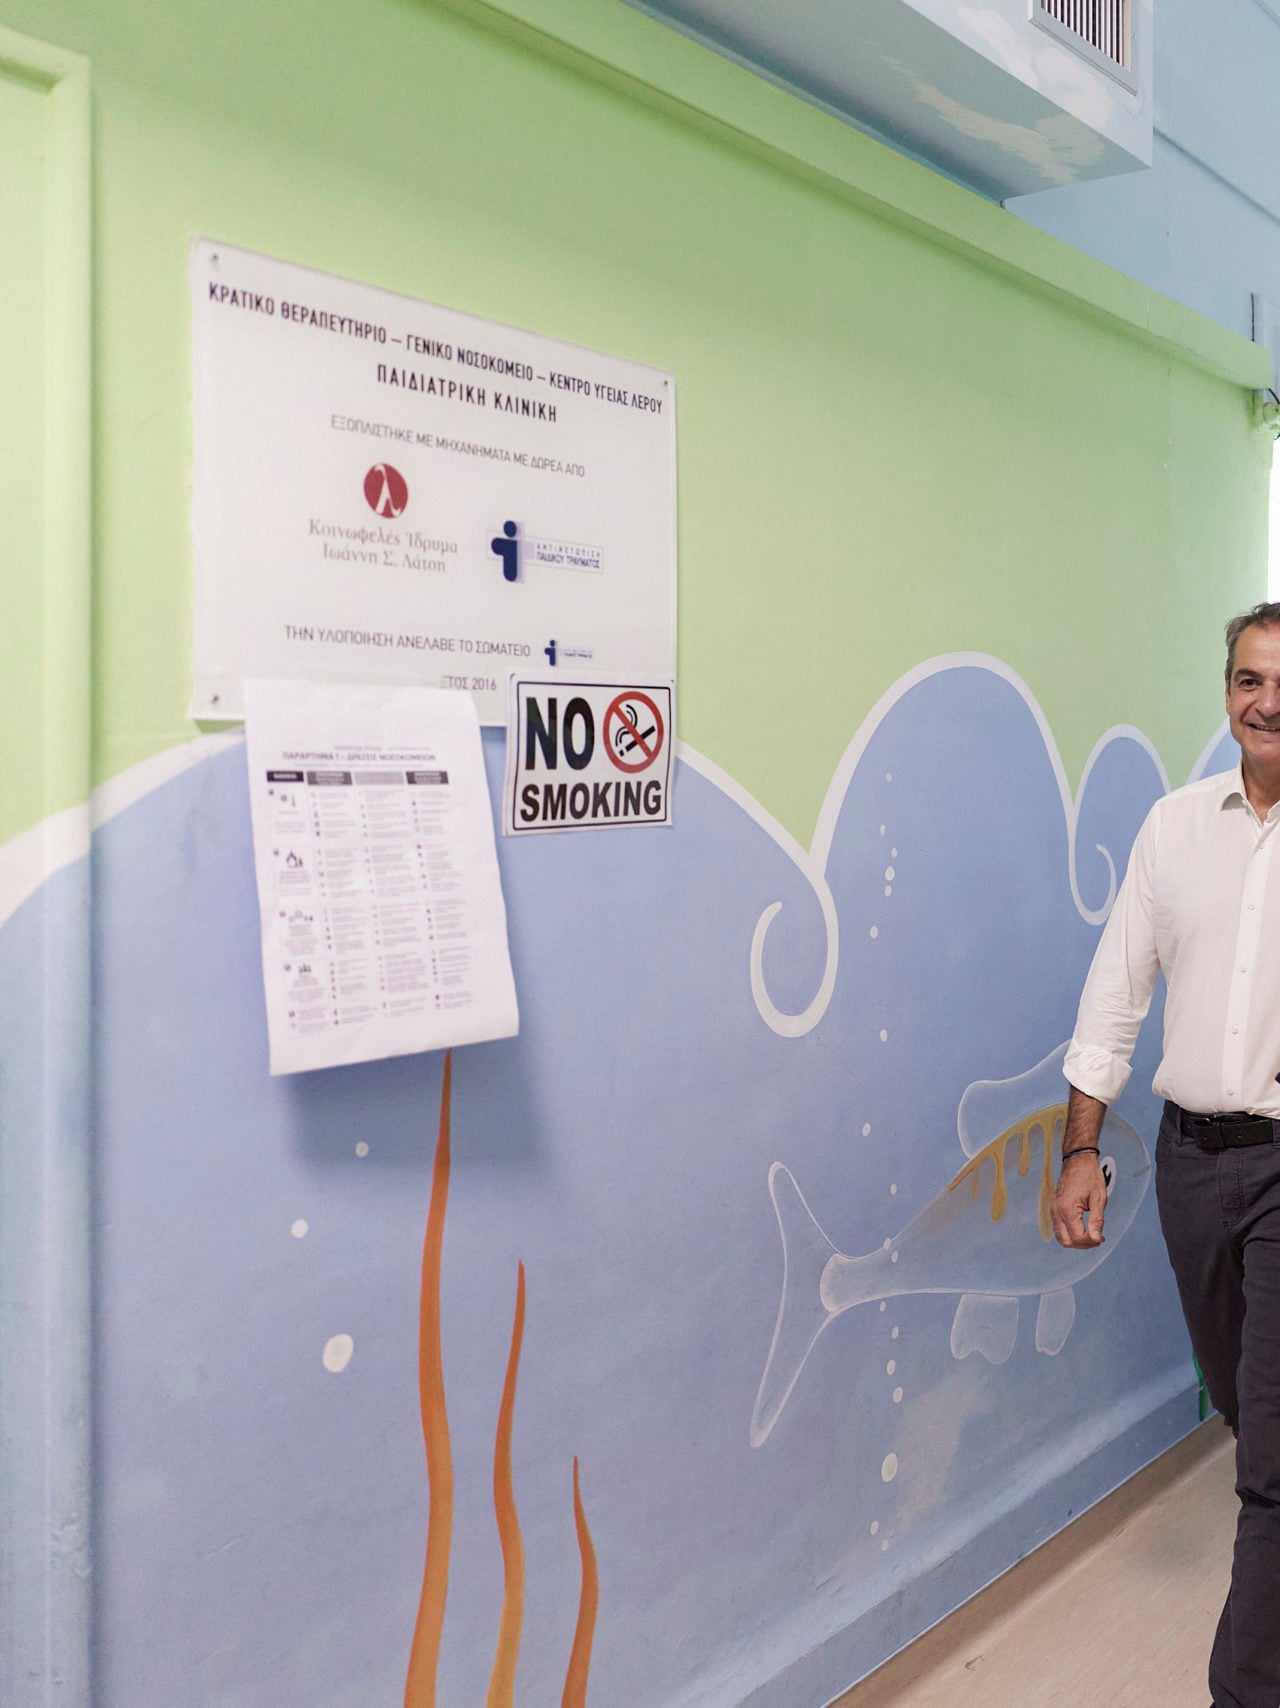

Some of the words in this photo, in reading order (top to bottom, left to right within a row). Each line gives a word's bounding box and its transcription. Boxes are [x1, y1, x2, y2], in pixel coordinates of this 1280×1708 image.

[209, 282, 274, 315] ΚΡΑΤΙΚΟ
[281, 302, 386, 344] ΘΕΡΑΠΕΥΤΗΡΙΟ
[407, 334, 451, 361] ΓΕΝΙΚΟ
[457, 347, 533, 382] ΝΟΣΟΚΟΜΕΙΟ
[550, 372, 590, 396] ΚΕΝΤΡΟ
[594, 383, 628, 406] ΥΓΕΙΑΣ
[631, 393, 663, 414] ΛΕΡΟΥ
[377, 364, 486, 406] ΠΑΙΔΙΑΤΡΙΚΗ
[494, 392, 557, 422] ΚΛΙΝΙΚΗ
[331, 414, 413, 444] ΕΞΟΠΛΙΣΤΗΚΕ
[416, 432, 433, 448] ΜΕ
[436, 436, 511, 462] ΜΗΧΑΝΗΜΑΤΑ
[513, 452, 528, 467] ΜΕ
[531, 455, 563, 473] ΔΩΡΕΑ
[565, 464, 585, 477] ΑΠΟ
[309, 519, 401, 546] Κοινωφελές
[323, 543, 378, 564] Ιωάννη
[285, 625, 313, 640] ΤΗΝ
[318, 629, 393, 647] ΥΛΟΠΟΙΗΣΗ
[397, 635, 456, 651] ΑΝΕΛΑΒΕ
[459, 639, 472, 652] ΤΟ
[476, 641, 531, 657] ΣΩΜΑΤΕΙΟ
[472, 677, 496, 691] 2016
[525, 697, 595, 771] NO
[520, 780, 662, 822] SMOKING
